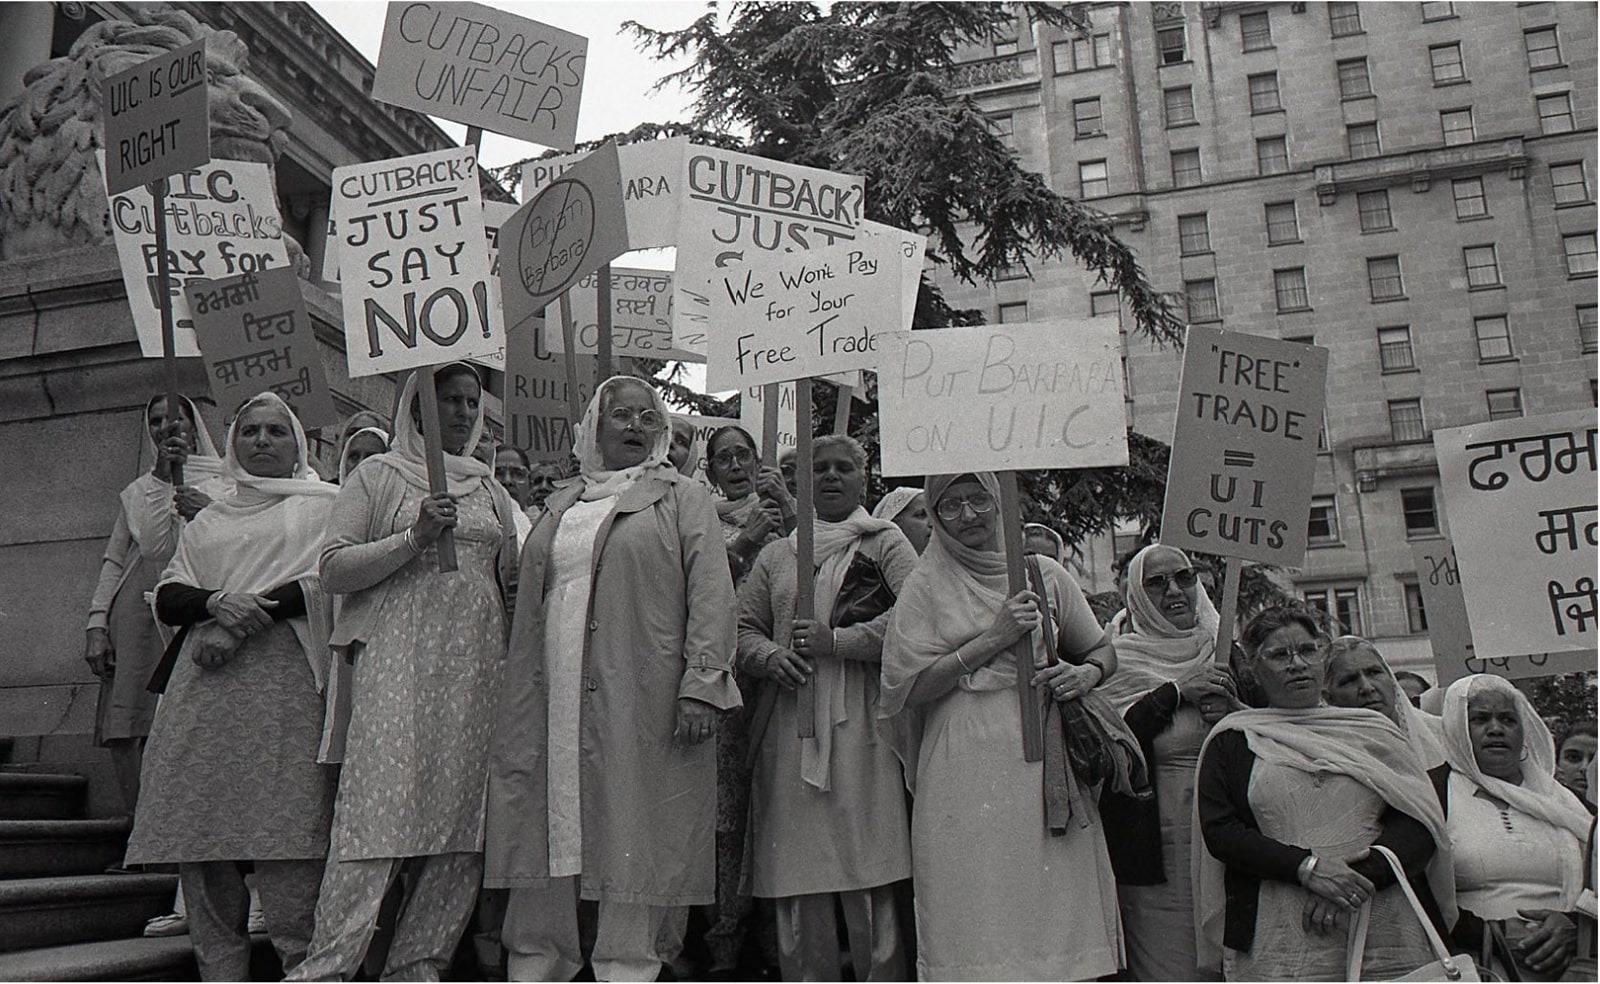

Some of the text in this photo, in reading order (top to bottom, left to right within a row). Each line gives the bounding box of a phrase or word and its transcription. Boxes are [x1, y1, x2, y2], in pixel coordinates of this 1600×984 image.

[400, 3, 586, 87] CUTBACKS
[149, 67, 162, 98] IS
[169, 50, 202, 89] OUR
[415, 59, 563, 130] UNFAIR
[120, 119, 180, 174] RIGHT
[340, 156, 475, 199] CUTBACK?
[688, 155, 864, 226] CUTBACK?
[346, 196, 469, 247] JUST
[530, 199, 583, 249] Brian
[217, 241, 274, 273] for
[367, 241, 466, 289] SAY
[525, 238, 584, 289] Barbara
[724, 250, 878, 306] We Won't Pay
[364, 280, 491, 359] NO!
[765, 301, 796, 321] for
[735, 334, 796, 375] Free
[902, 334, 1118, 399] PUT BARBARA
[906, 421, 953, 453] ON
[1193, 392, 1306, 440] TRADE
[1187, 507, 1289, 549] CUTS
